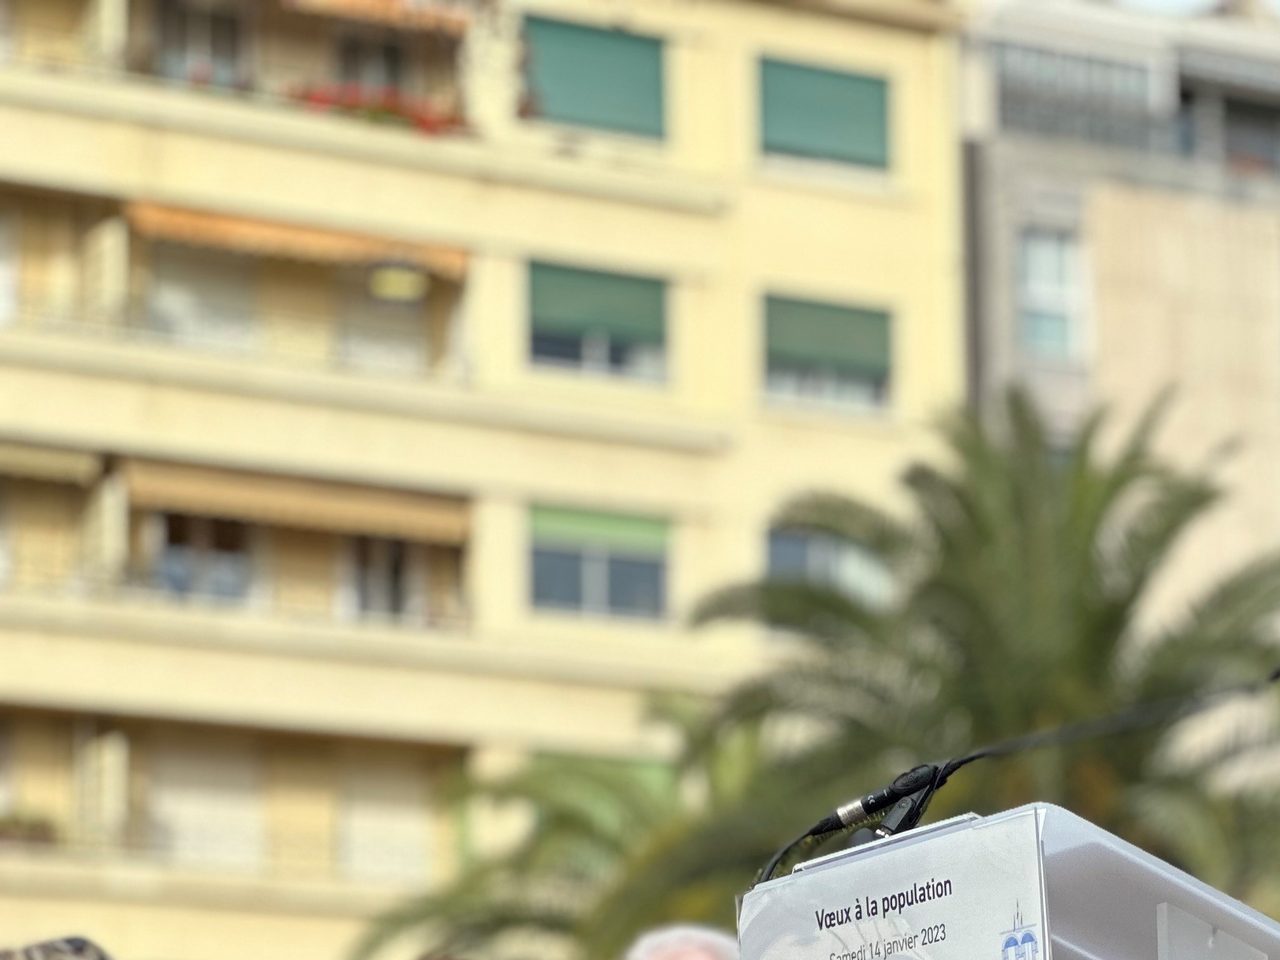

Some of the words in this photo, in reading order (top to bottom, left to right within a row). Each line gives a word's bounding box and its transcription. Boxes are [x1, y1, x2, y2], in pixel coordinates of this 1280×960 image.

[815, 908, 852, 931] Vœux
[854, 898, 863, 920] à
[865, 896, 878, 917] la
[881, 878, 953, 919] population
[868, 941, 881, 960] 14
[883, 931, 919, 960] janvier
[920, 923, 947, 946] 2023
